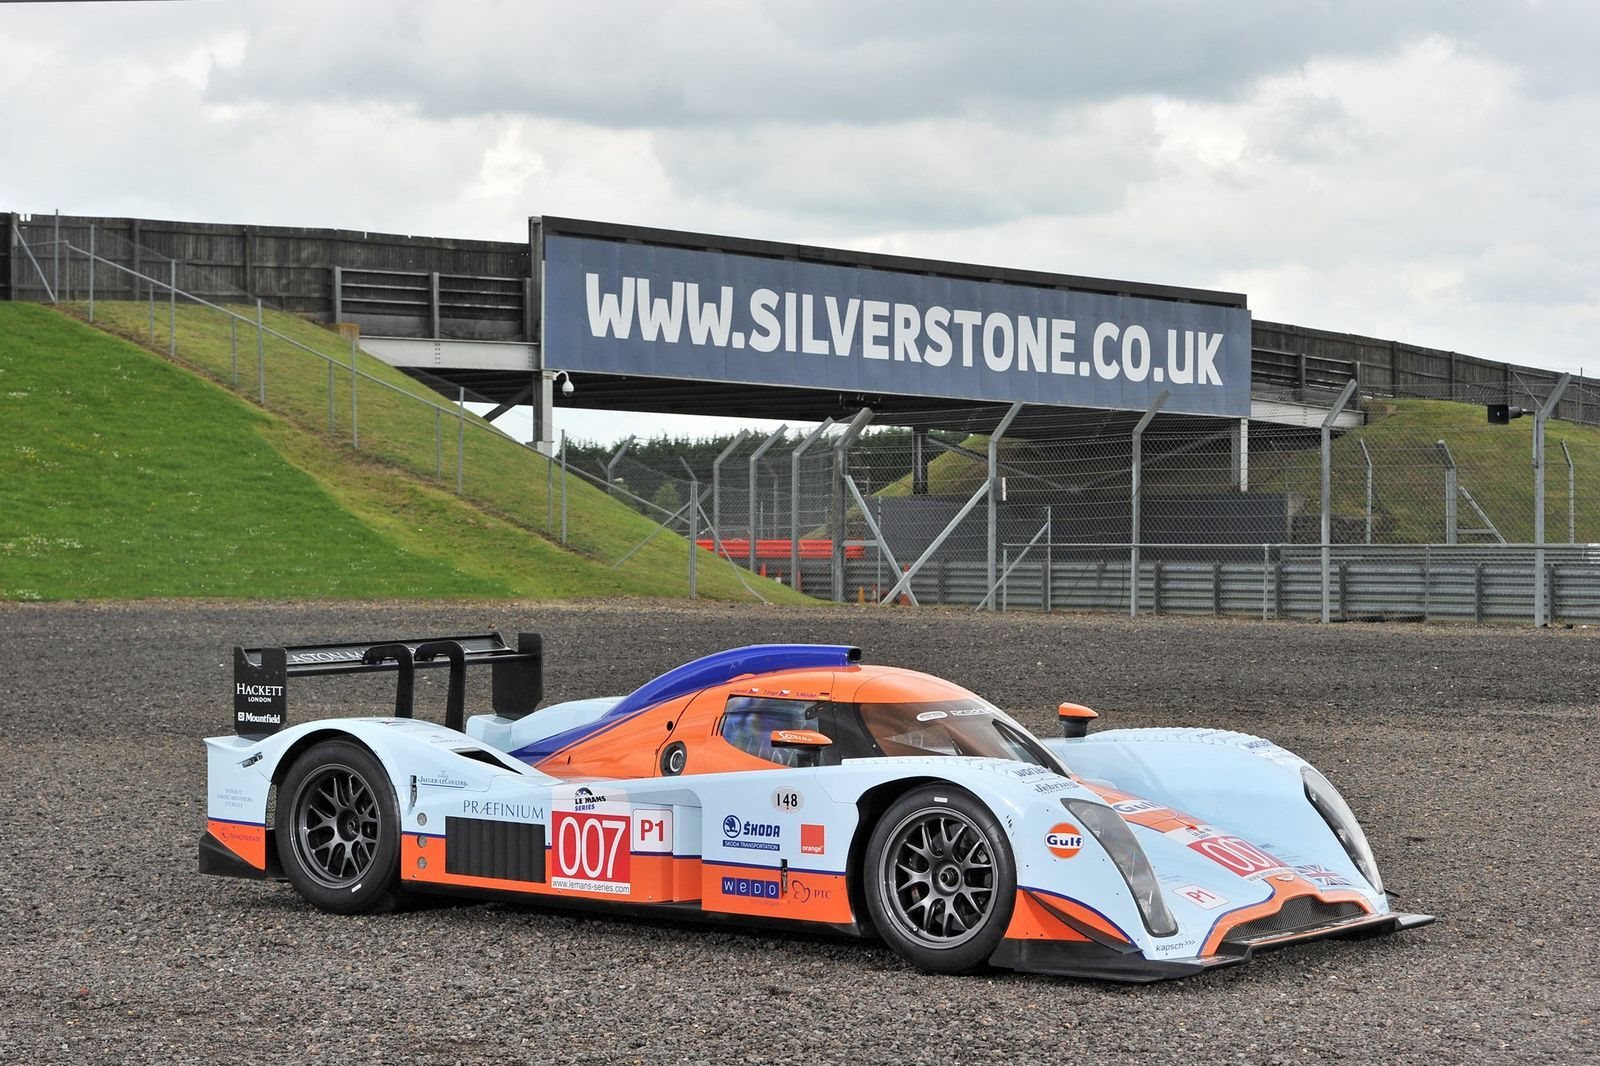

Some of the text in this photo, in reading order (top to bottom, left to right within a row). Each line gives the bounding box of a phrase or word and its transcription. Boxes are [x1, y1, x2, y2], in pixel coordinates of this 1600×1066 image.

[585, 272, 1224, 387] WWW.SILVERSTONE.CO.UK
[291, 650, 345, 664] ASTON
[236, 683, 284, 697] HACKETT
[245, 712, 281, 724] Mountfield
[585, 795, 607, 804] MANS
[776, 793, 798, 807] 148
[463, 799, 544, 820] PRÆFINIUM
[575, 804, 596, 812] SERIES
[640, 819, 664, 842] P1
[743, 821, 781, 838] ŠKODA
[558, 816, 626, 879] 007
[1046, 834, 1083, 848] Gulf
[801, 845, 823, 853] orange
[552, 879, 630, 894] www.lemans-series.com
[1185, 889, 1217, 904] P1
[1155, 942, 1184, 952] kapsch
